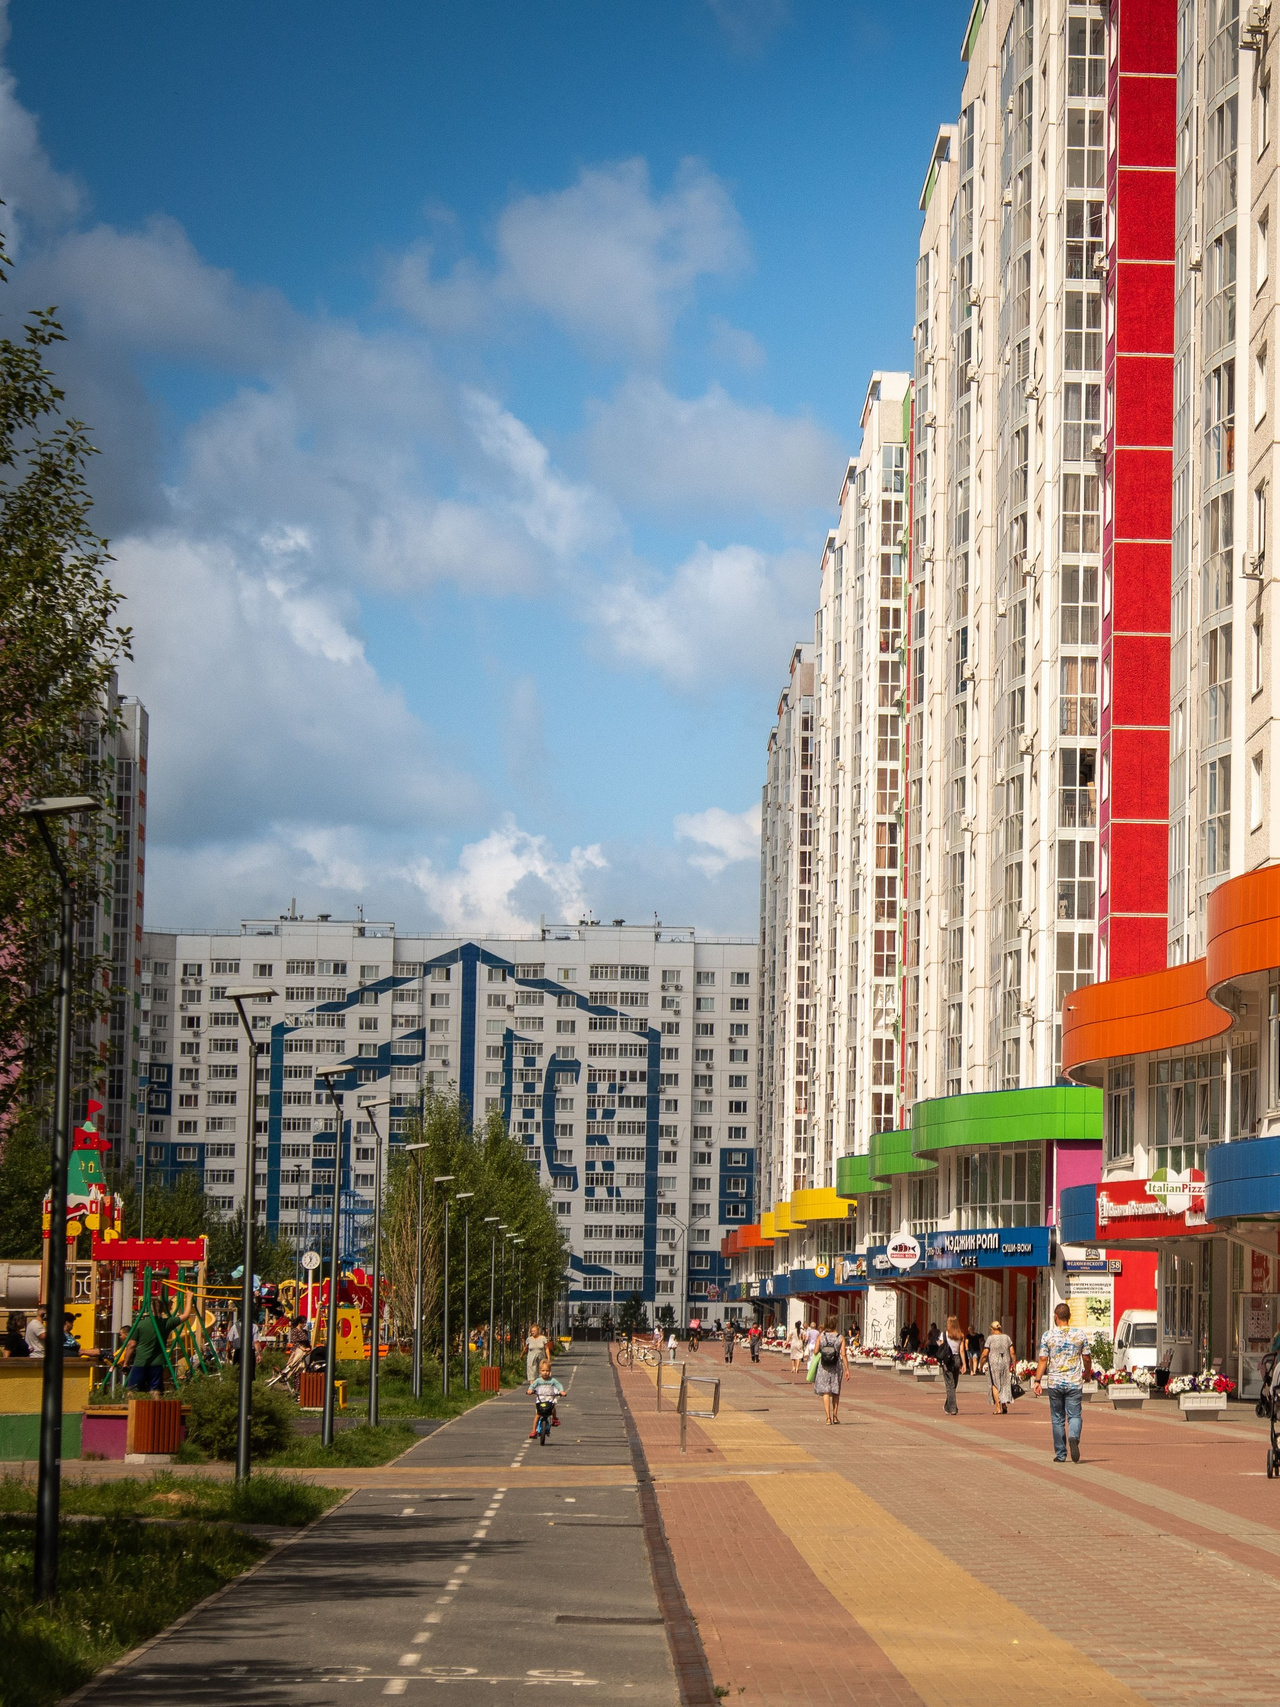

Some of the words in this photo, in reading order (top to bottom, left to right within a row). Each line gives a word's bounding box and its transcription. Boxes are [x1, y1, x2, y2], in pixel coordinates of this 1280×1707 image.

[944, 1234, 976, 1253] МЭДЖИК
[976, 1233, 1000, 1249] РОЛЛ
[1001, 1243, 1032, 1253] СУШИ-ВОКИ
[960, 1256, 977, 1266] CAFE
[1110, 1261, 1120, 1269] 58
